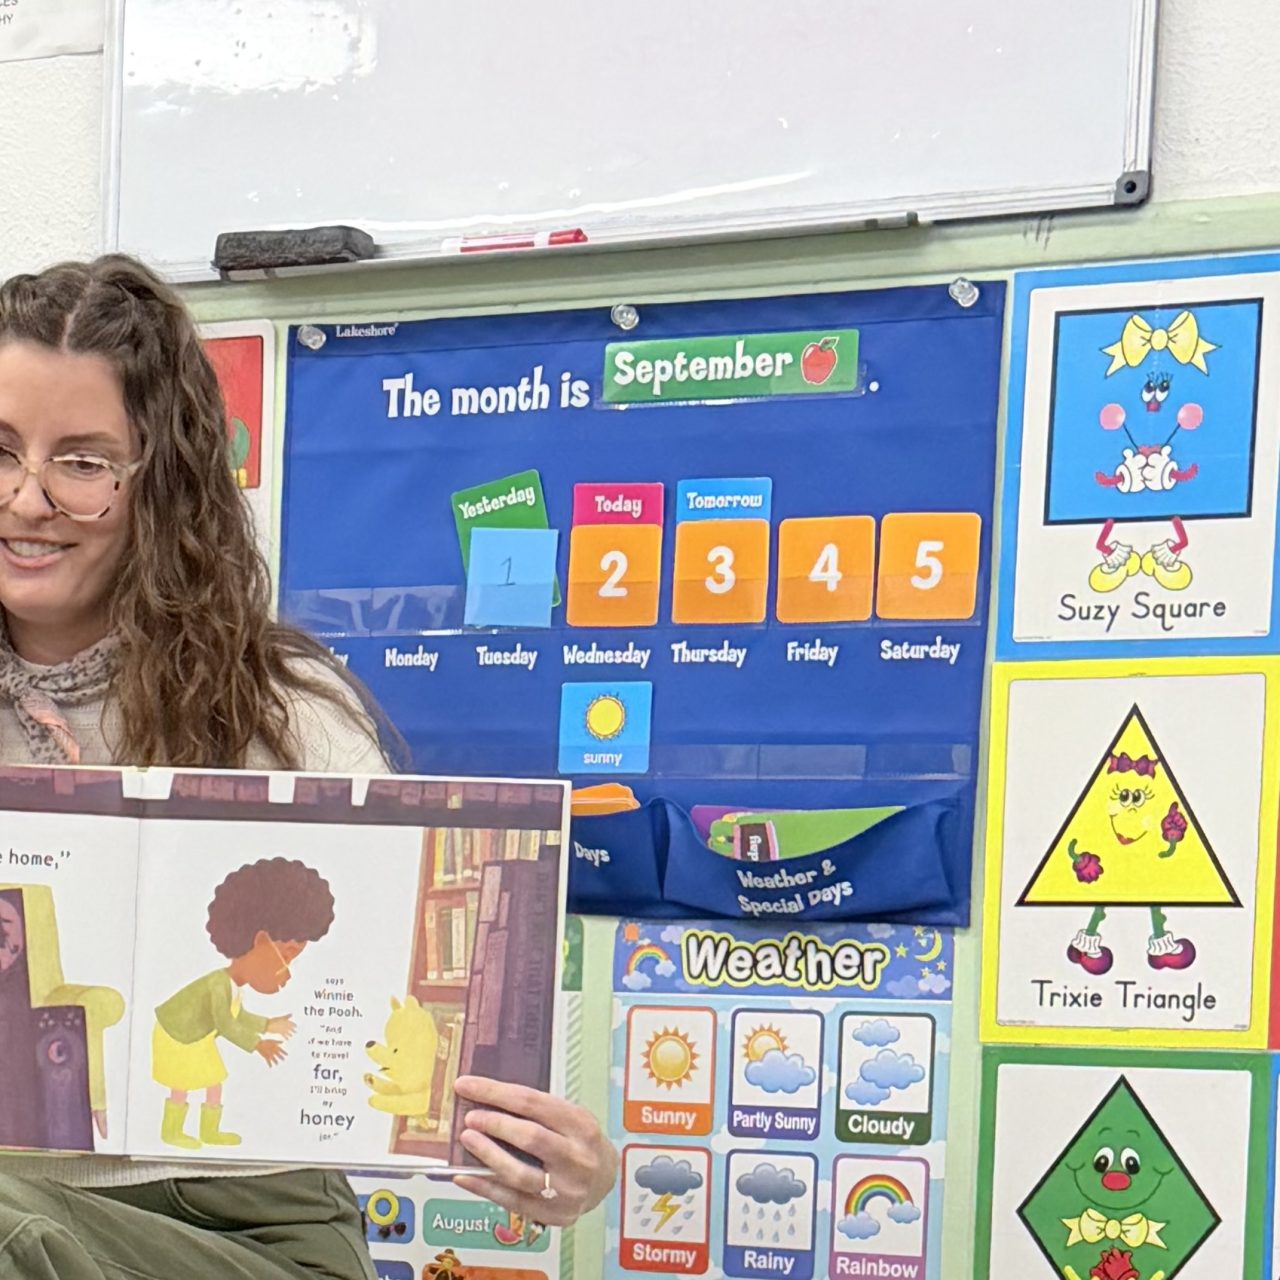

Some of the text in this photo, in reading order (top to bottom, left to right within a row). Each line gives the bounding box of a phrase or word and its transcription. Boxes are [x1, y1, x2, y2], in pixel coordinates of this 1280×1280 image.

[336, 322, 399, 338] Lakeshore
[382, 340, 794, 419] The month is September
[458, 484, 536, 520] Yesterday
[595, 493, 643, 519] Today
[686, 490, 763, 511] Tomorrow
[500, 555, 516, 587] 1
[598, 551, 629, 597] 2
[705, 545, 736, 594] 3
[809, 543, 843, 593] 4
[910, 540, 945, 591] 5
[1058, 590, 1227, 633] Suzy Square
[385, 645, 439, 672] Monday
[476, 644, 538, 669] Tuesday
[562, 643, 651, 669] Wednesday
[671, 641, 748, 667] Thursday
[786, 640, 840, 667] Friday
[880, 637, 961, 665] Saturday
[583, 751, 623, 767] sunny
[9, 848, 71, 870] home,"
[574, 841, 610, 867] Days
[737, 859, 837, 889] Weather &
[738, 878, 853, 916] Special Days
[685, 932, 888, 988] Weather
[314, 988, 354, 1001] Winnie
[1031, 978, 1217, 1022] Trixie Triangle
[304, 1005, 325, 1017] the
[331, 1038, 352, 1046] have
[311, 1051, 349, 1060] to travel
[313, 1063, 343, 1084] far,
[324, 1085, 347, 1096] bring
[322, 1100, 333, 1108] my
[641, 1106, 697, 1127] Sunny
[300, 1108, 355, 1131] honey
[733, 1110, 816, 1134] Partly Sunny
[848, 1115, 915, 1138] Cloudy
[432, 1213, 490, 1234] August
[633, 1243, 697, 1268] Stormy
[744, 1250, 795, 1275] Rainy
[836, 1258, 919, 1279] Rainbow
